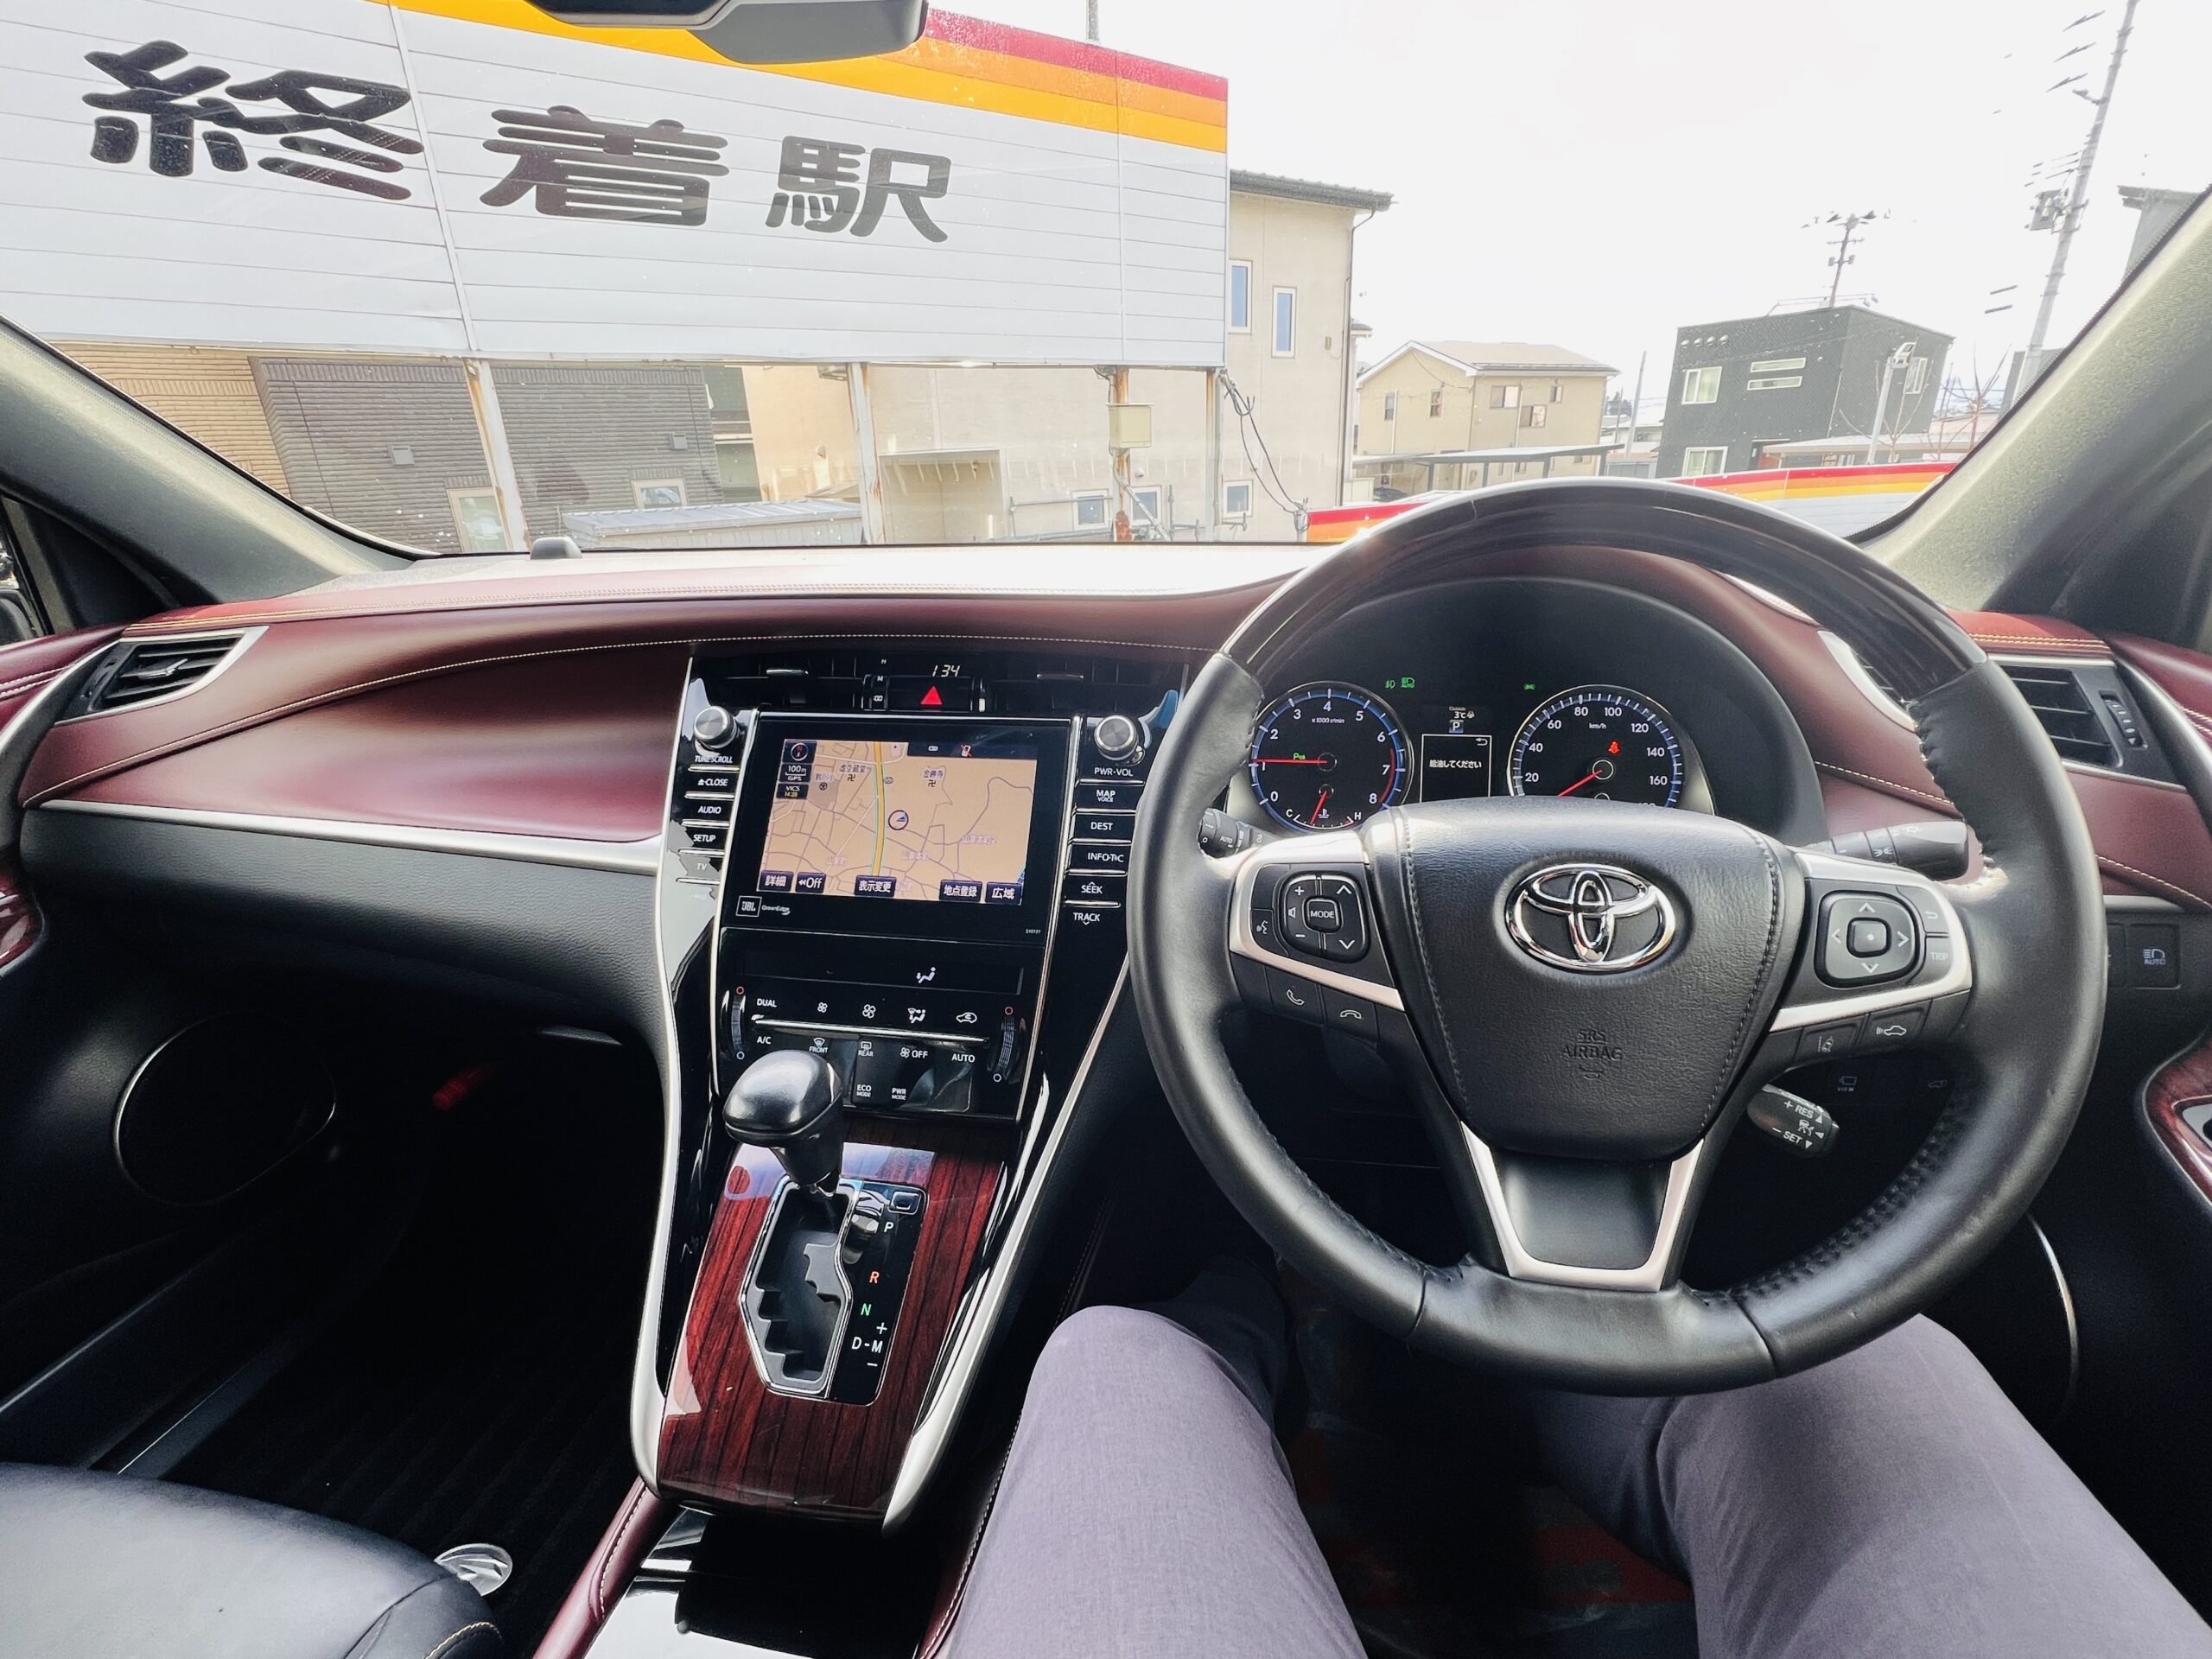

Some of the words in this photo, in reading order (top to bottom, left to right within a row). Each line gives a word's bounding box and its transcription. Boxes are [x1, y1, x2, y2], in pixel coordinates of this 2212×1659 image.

[82, 39, 953, 244] 終着駅
[1323, 701, 1332, 712] 4
[1573, 707, 1589, 716] 80
[1604, 707, 1623, 716] 100
[1294, 709, 1301, 720] 3
[1355, 710, 1364, 721] 5
[1547, 720, 1562, 729] 60
[1631, 723, 1649, 734] 120
[1270, 729, 1279, 740] 2
[1376, 731, 1386, 742] 6
[1529, 742, 1544, 753] 40
[1646, 747, 1665, 758] 140
[1382, 765, 1389, 776] 7
[1525, 772, 1540, 783] 20
[1649, 776, 1668, 785] 160
[1096, 789, 1116, 798] MAP
[1270, 791, 1279, 803] 0
[1369, 793, 1377, 804] 8
[697, 805, 722, 815] AUDIO
[1286, 809, 1294, 818] C
[1354, 811, 1362, 821] H
[1090, 822, 1114, 831] DEST
[693, 834, 716, 842] SETUP
[696, 862, 708, 871] TV
[944, 884, 978, 898] 地点登録
[991, 887, 1015, 900] 広域
[1081, 884, 1103, 894] SEEK
[741, 901, 756, 912] JBL
[1072, 912, 1101, 922] TRACK
[1310, 911, 1335, 919] MODE
[757, 998, 778, 1007] DUAL
[757, 1036, 772, 1045] A/C
[912, 1050, 929, 1058] OFF
[951, 1053, 976, 1063] AUTO
[1561, 1045, 1624, 1062] AIRBAG
[1795, 1104, 1815, 1119] RES
[1783, 1130, 1803, 1144] SET
[883, 1221, 894, 1233] P
[868, 1271, 880, 1283] R
[861, 1303, 872, 1316] N
